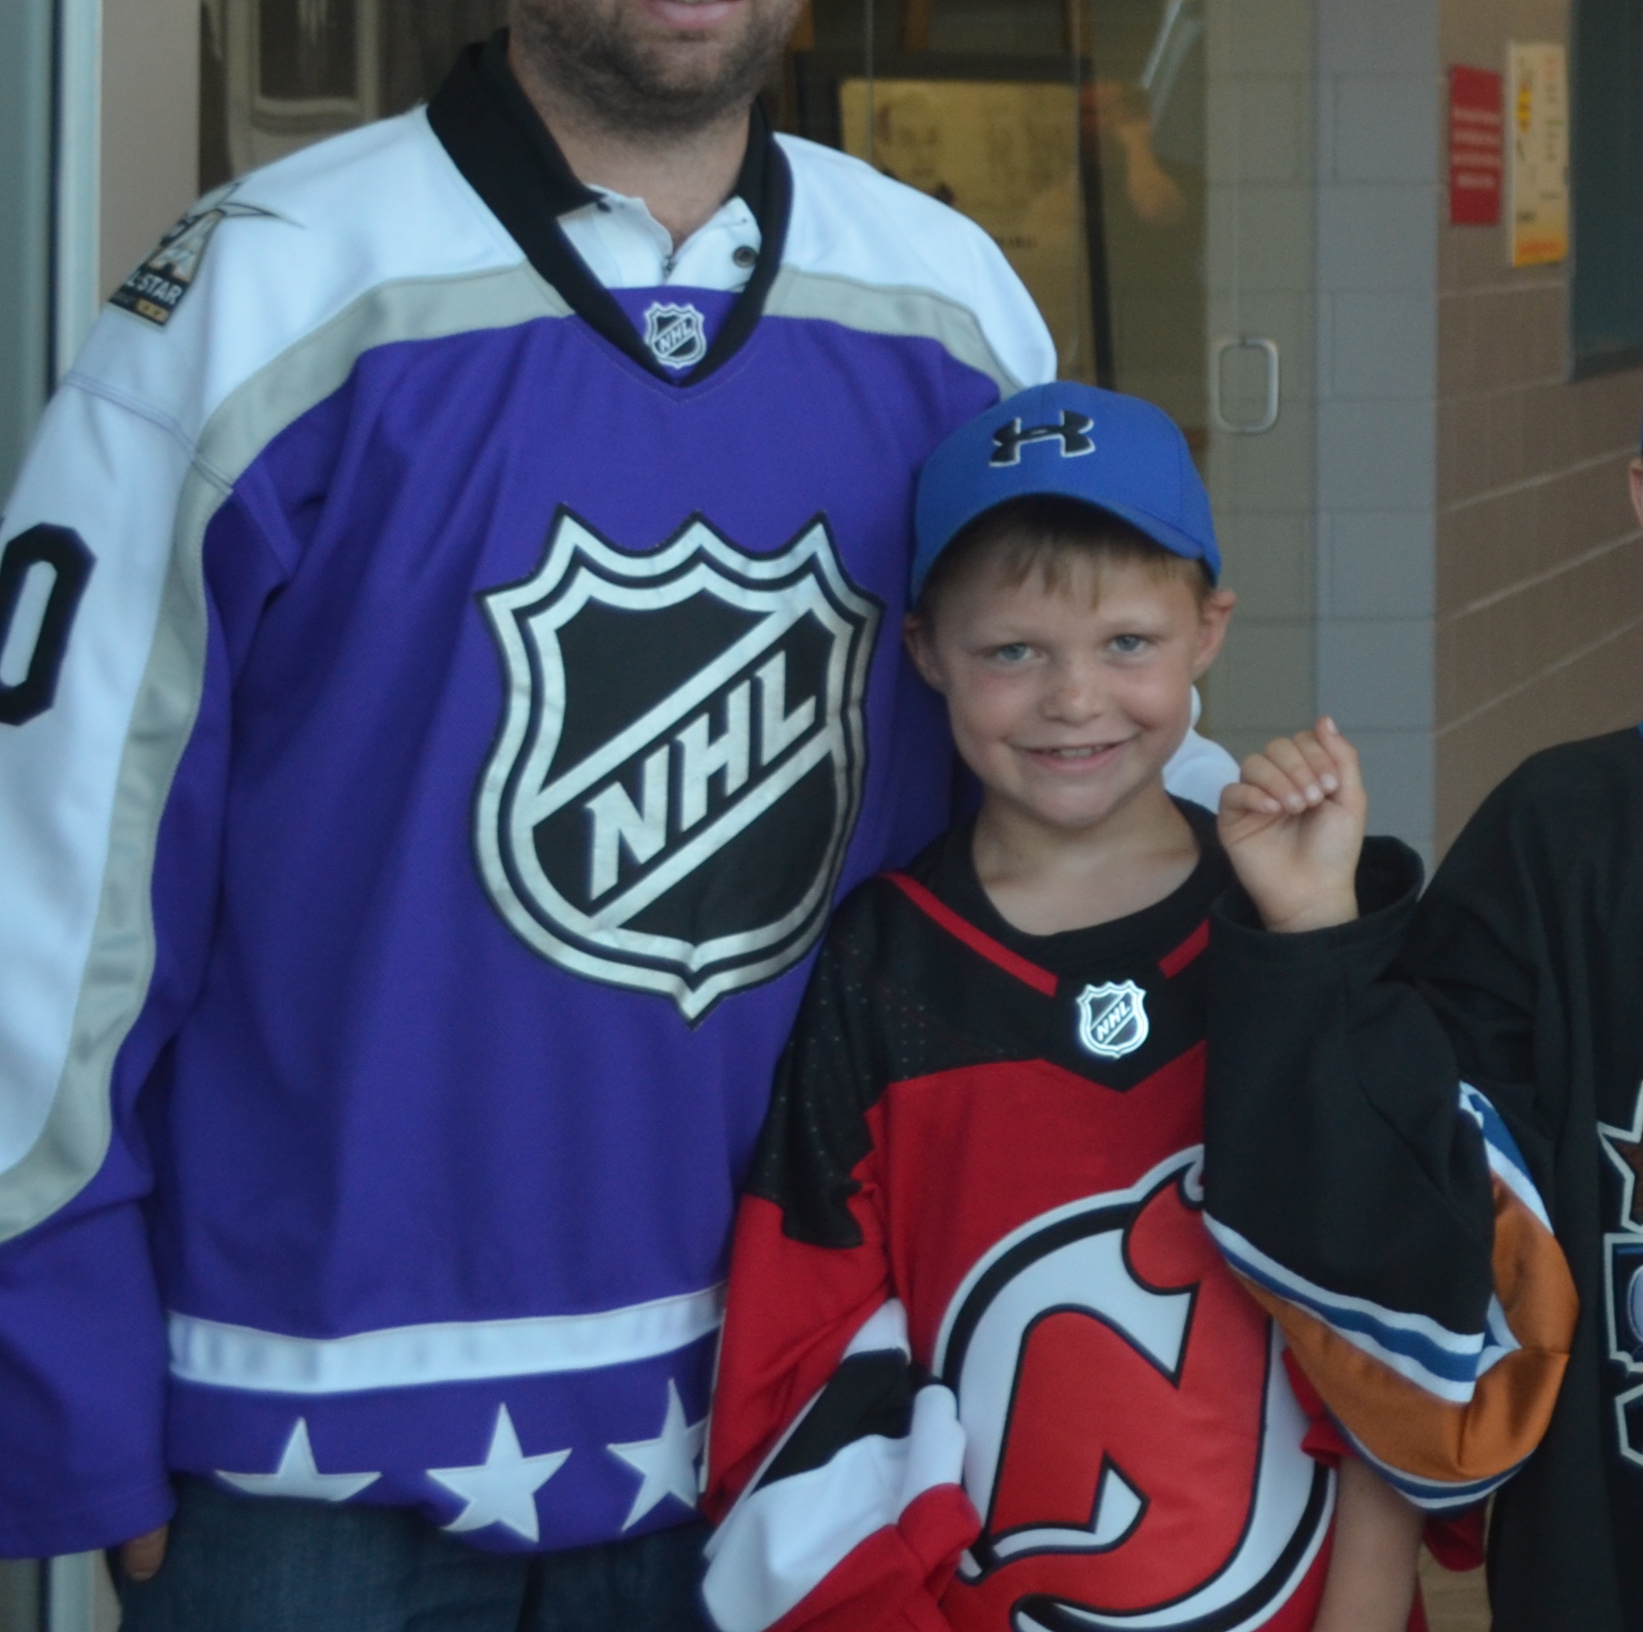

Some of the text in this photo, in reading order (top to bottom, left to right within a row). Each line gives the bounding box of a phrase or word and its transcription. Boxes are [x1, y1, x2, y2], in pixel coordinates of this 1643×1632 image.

[658, 320, 693, 355] NHL
[584, 649, 817, 902] NHL
[1096, 1000, 1132, 1042] NHL
